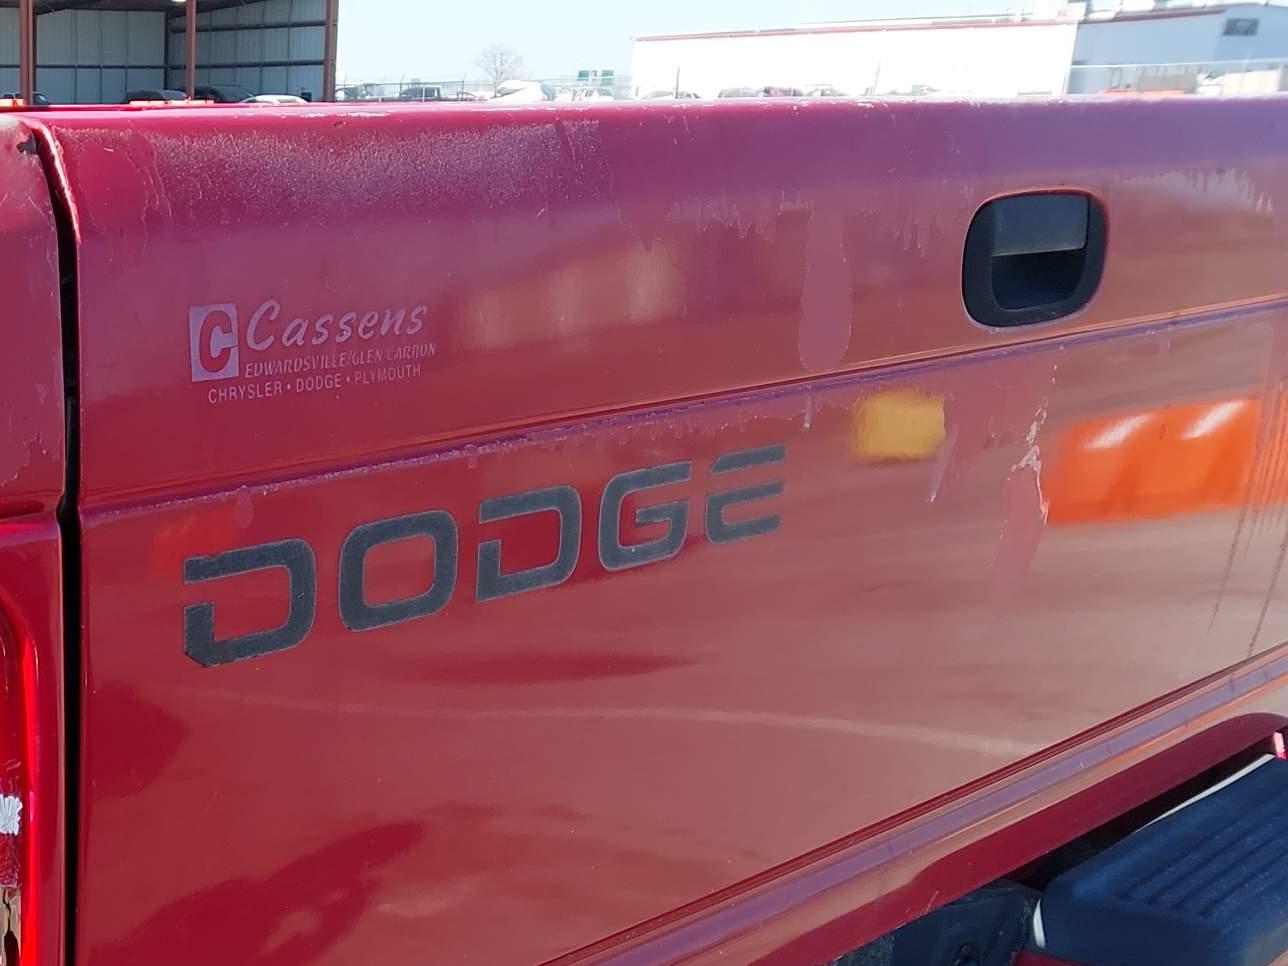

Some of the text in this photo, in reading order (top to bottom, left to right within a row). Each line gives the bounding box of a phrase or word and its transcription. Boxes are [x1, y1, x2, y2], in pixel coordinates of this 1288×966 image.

[246, 299, 428, 351] Cassens
[387, 343, 437, 363] CARBON
[207, 364, 422, 405] CHRYSLER DODGE PLYMOUTH
[183, 444, 786, 668] DODGE
